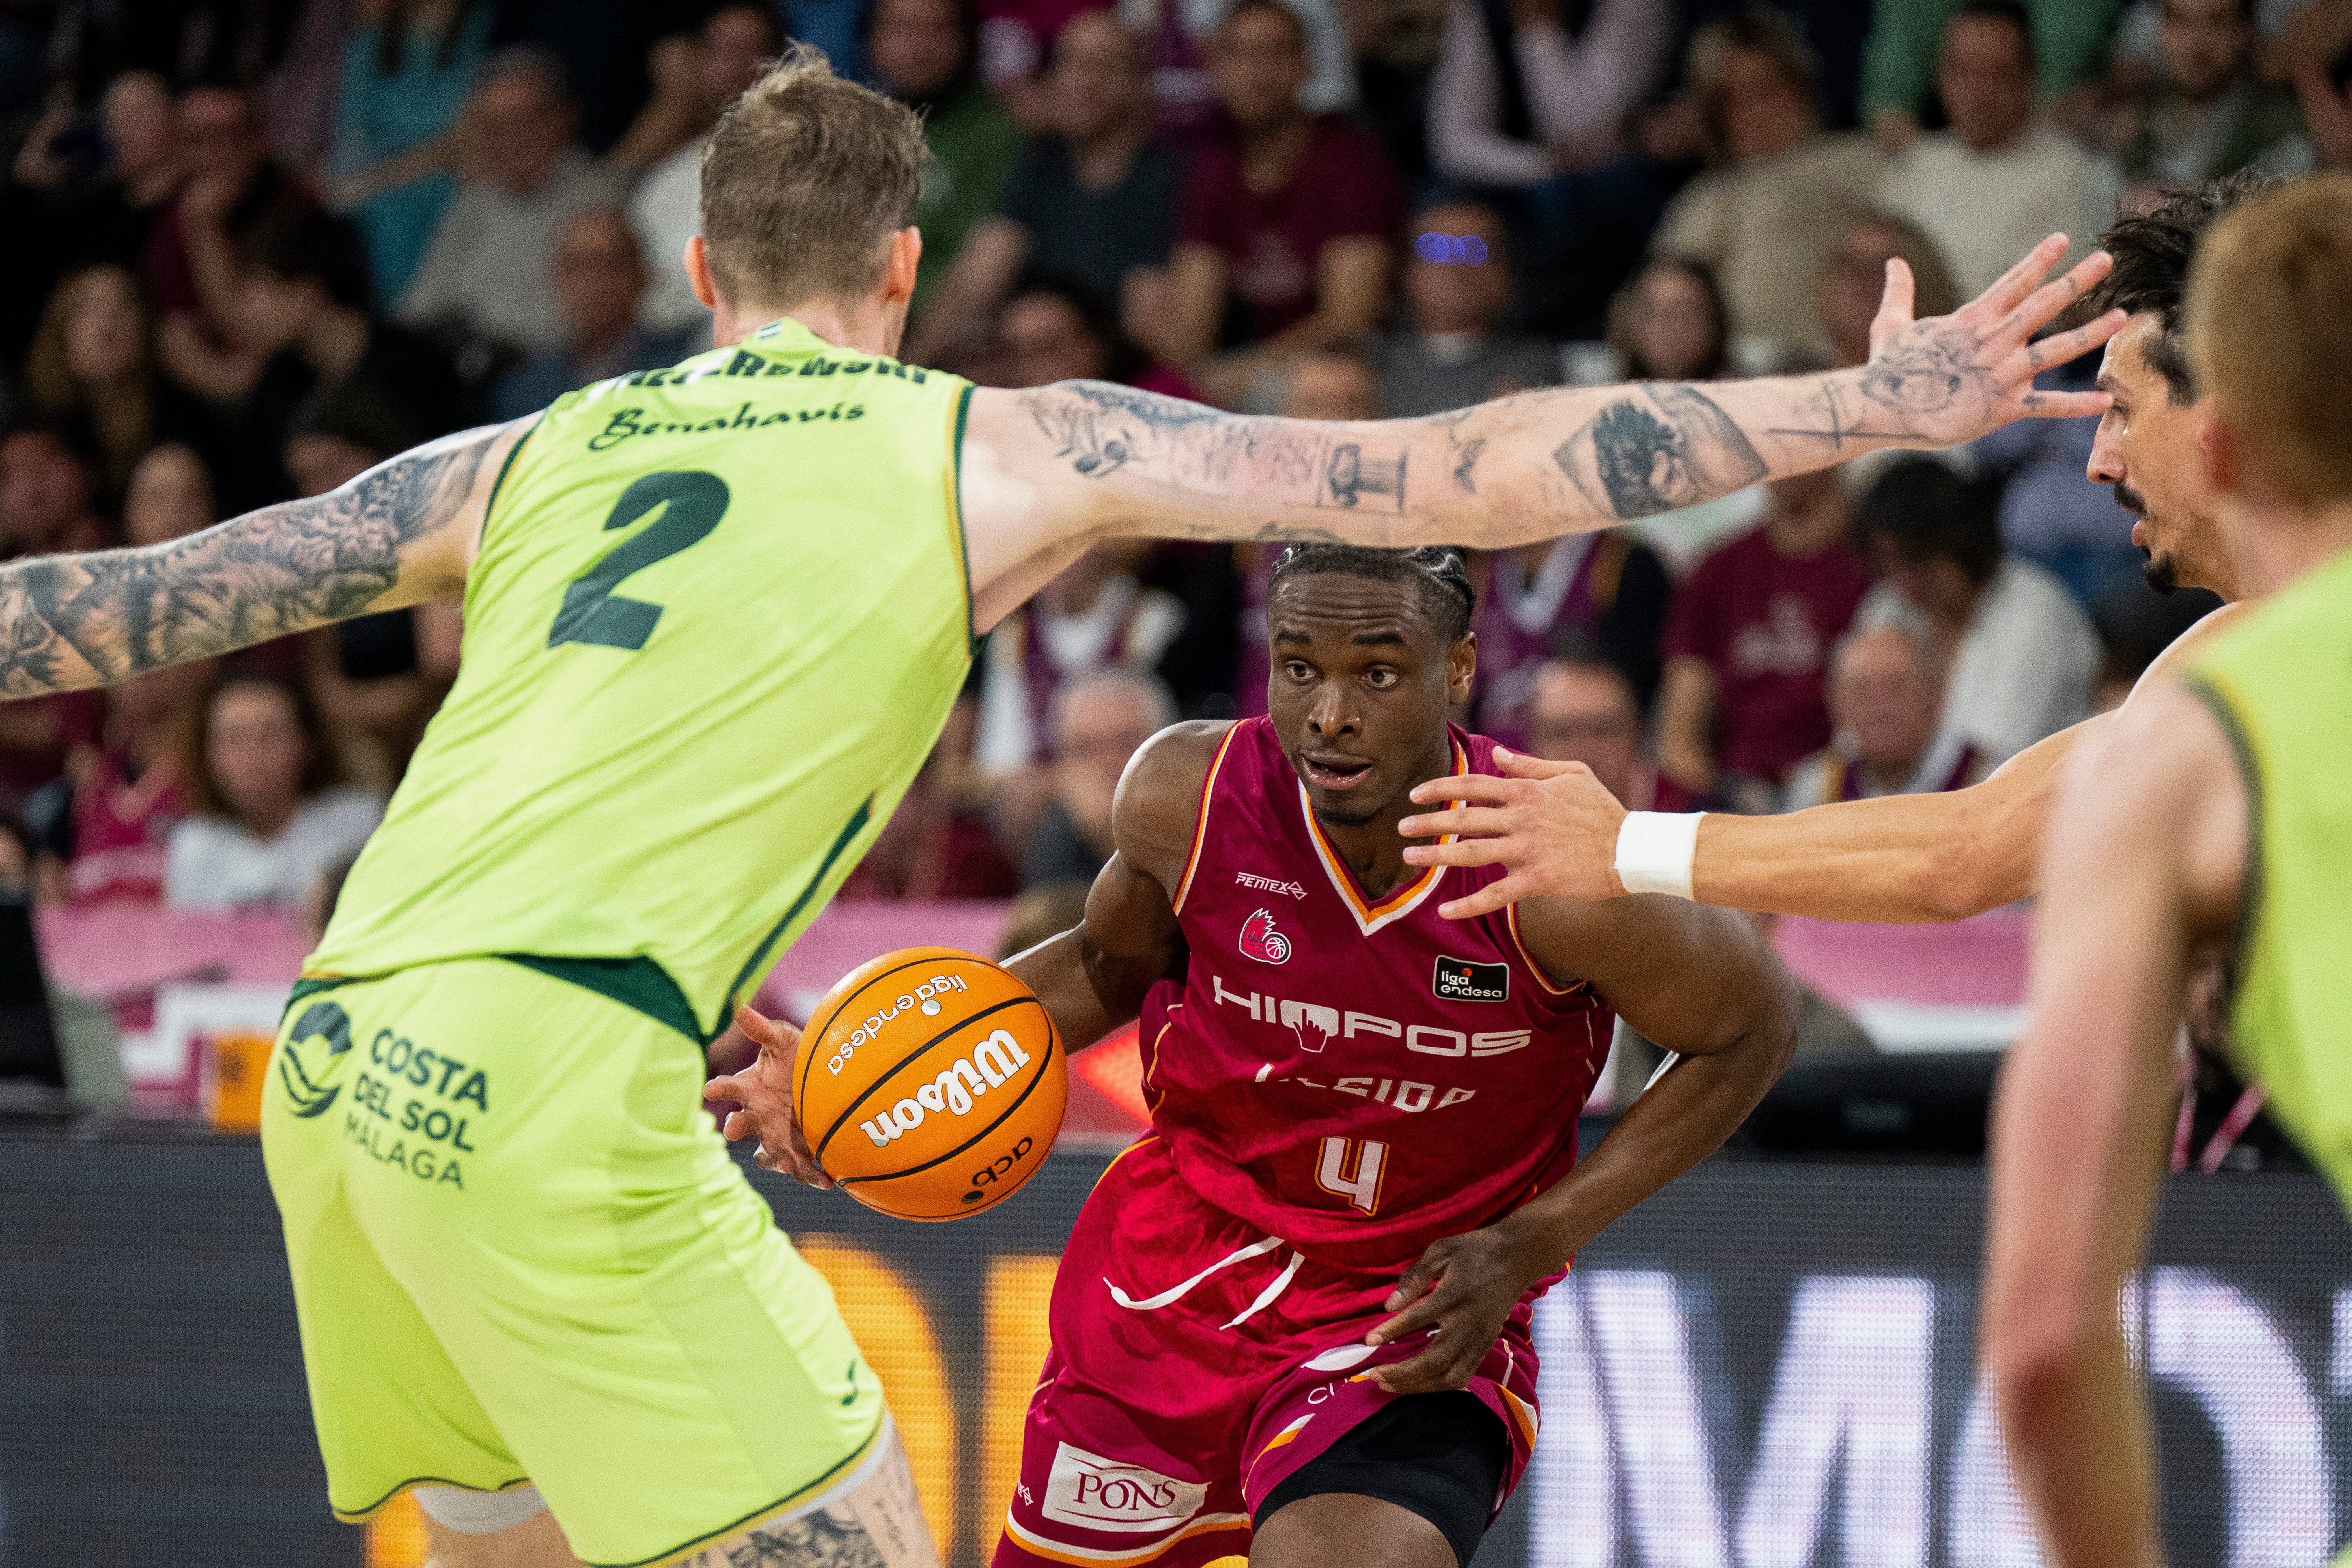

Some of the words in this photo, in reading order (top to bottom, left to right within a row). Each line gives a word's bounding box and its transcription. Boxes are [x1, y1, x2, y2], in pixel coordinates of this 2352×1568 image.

[547, 470, 731, 650] 2
[1235, 871, 1289, 895] PENTEX
[914, 974, 969, 1001] liga
[1441, 971, 1469, 985] liga
[1441, 985, 1502, 998] endesa
[827, 994, 915, 1077] endesa
[371, 1027, 489, 1113] COSTA
[859, 1029, 1031, 1147] Wilson
[354, 1071, 392, 1121] DEL
[400, 1100, 475, 1153] SOL
[971, 1136, 1033, 1187] acb
[1314, 1136, 1390, 1216] 4
[1073, 1471, 1178, 1510] PONS
